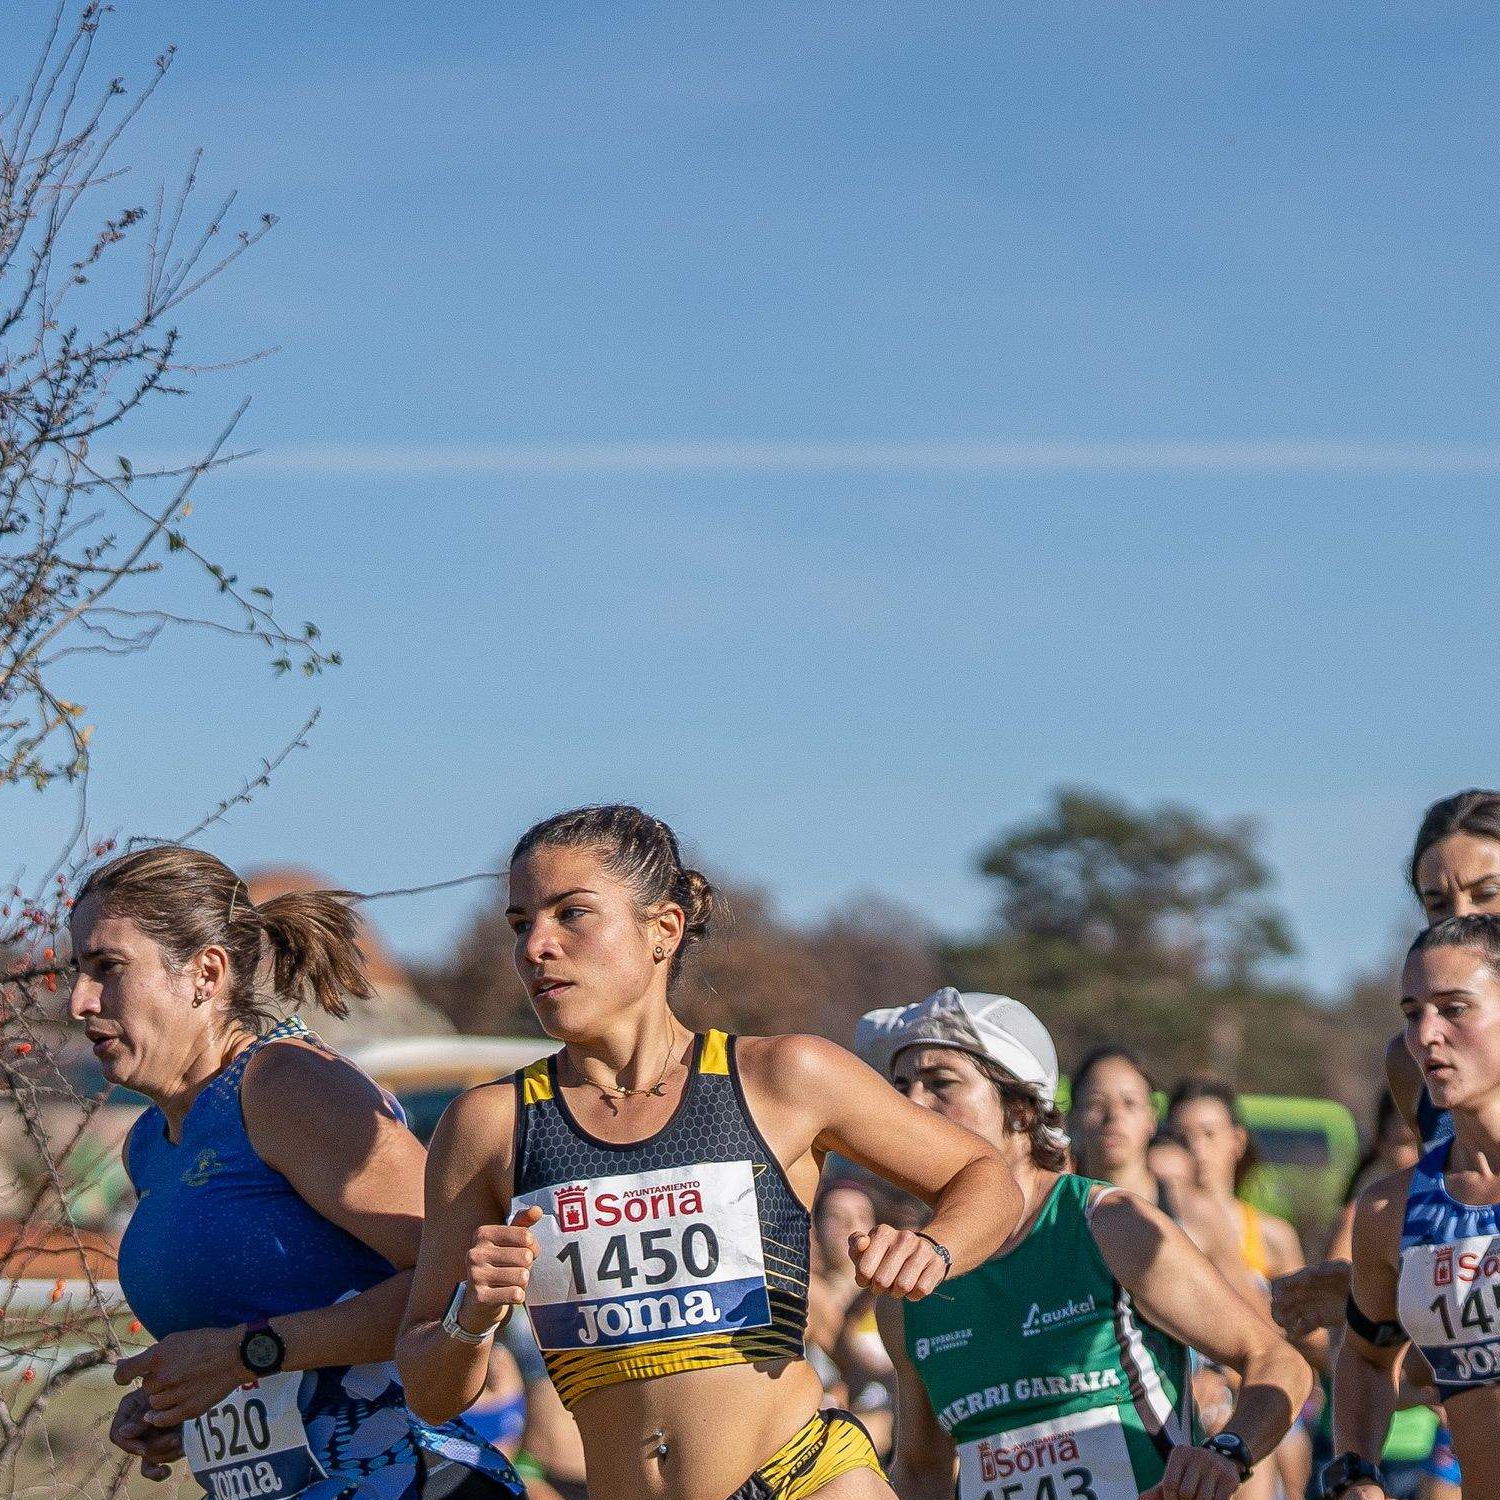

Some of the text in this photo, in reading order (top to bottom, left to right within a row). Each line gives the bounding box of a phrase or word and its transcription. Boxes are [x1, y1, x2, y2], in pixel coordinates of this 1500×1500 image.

[594, 1188, 704, 1227] Soria
[623, 1180, 701, 1199] AYUNTAMIENTO
[556, 1223, 720, 1295] 1450
[1014, 1367, 1121, 1400] GARAIA
[195, 1398, 271, 1463] 1520
